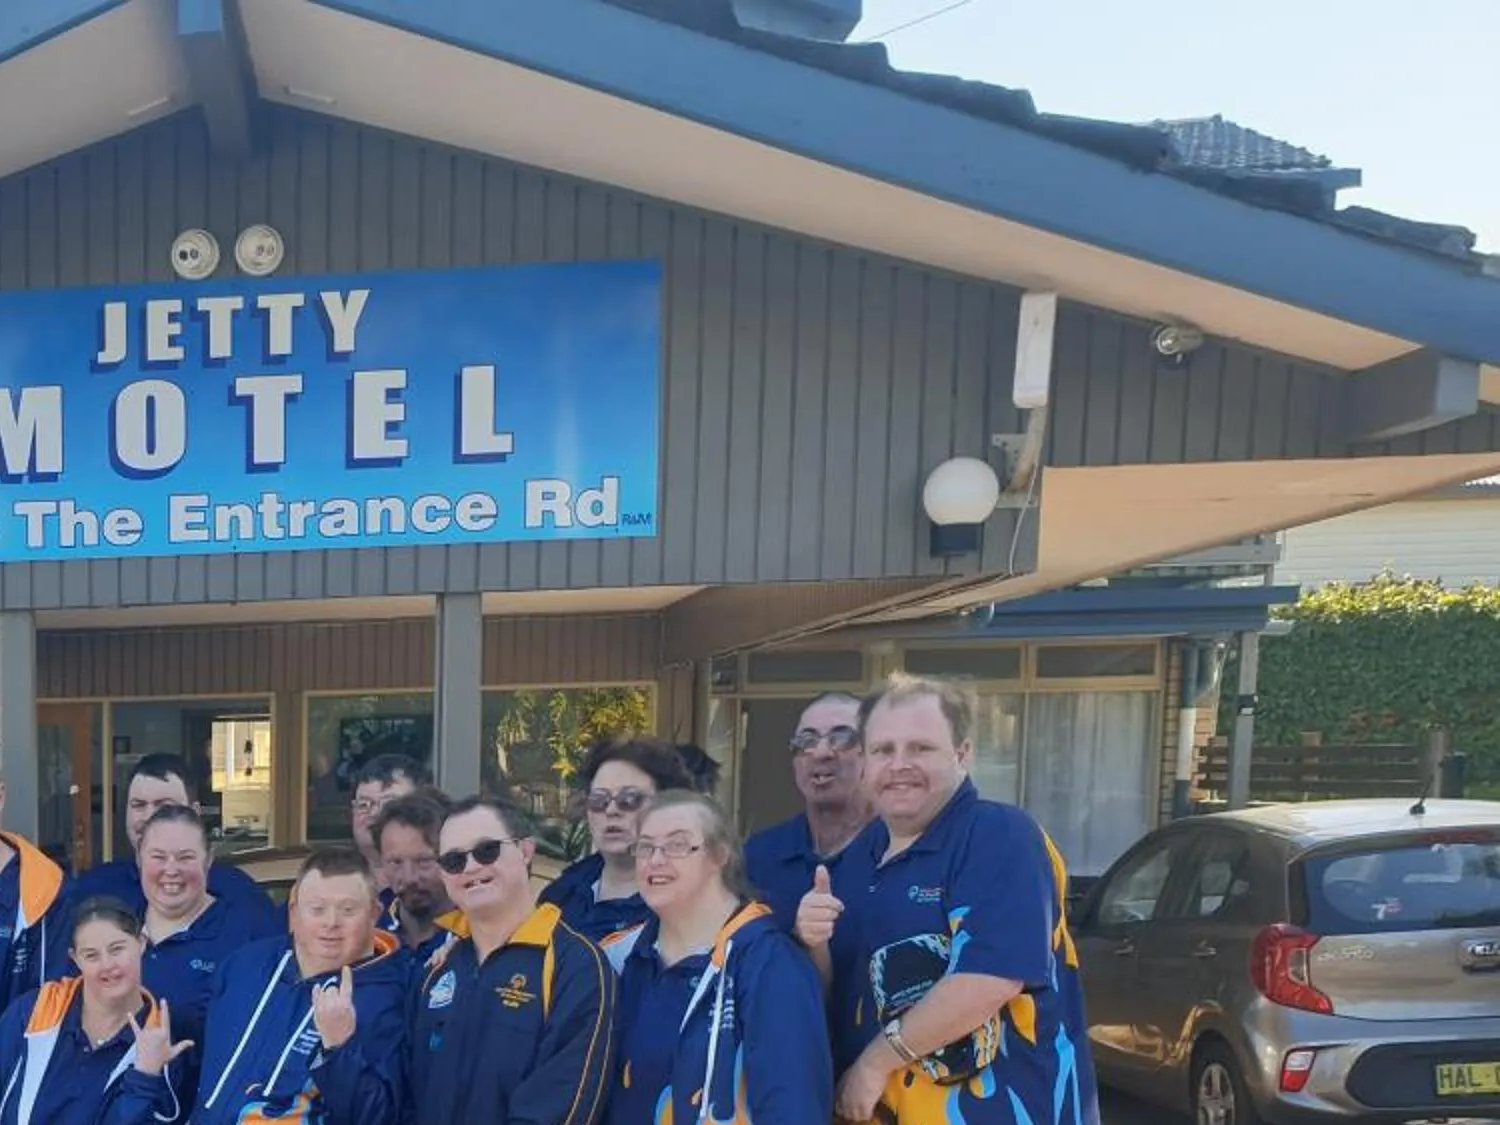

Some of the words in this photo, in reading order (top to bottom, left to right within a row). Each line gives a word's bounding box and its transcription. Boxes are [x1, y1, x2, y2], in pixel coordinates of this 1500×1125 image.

[92, 287, 371, 370] JETTY
[12, 499, 145, 548] The
[168, 491, 498, 543] Entrance
[524, 475, 619, 529] Rd
